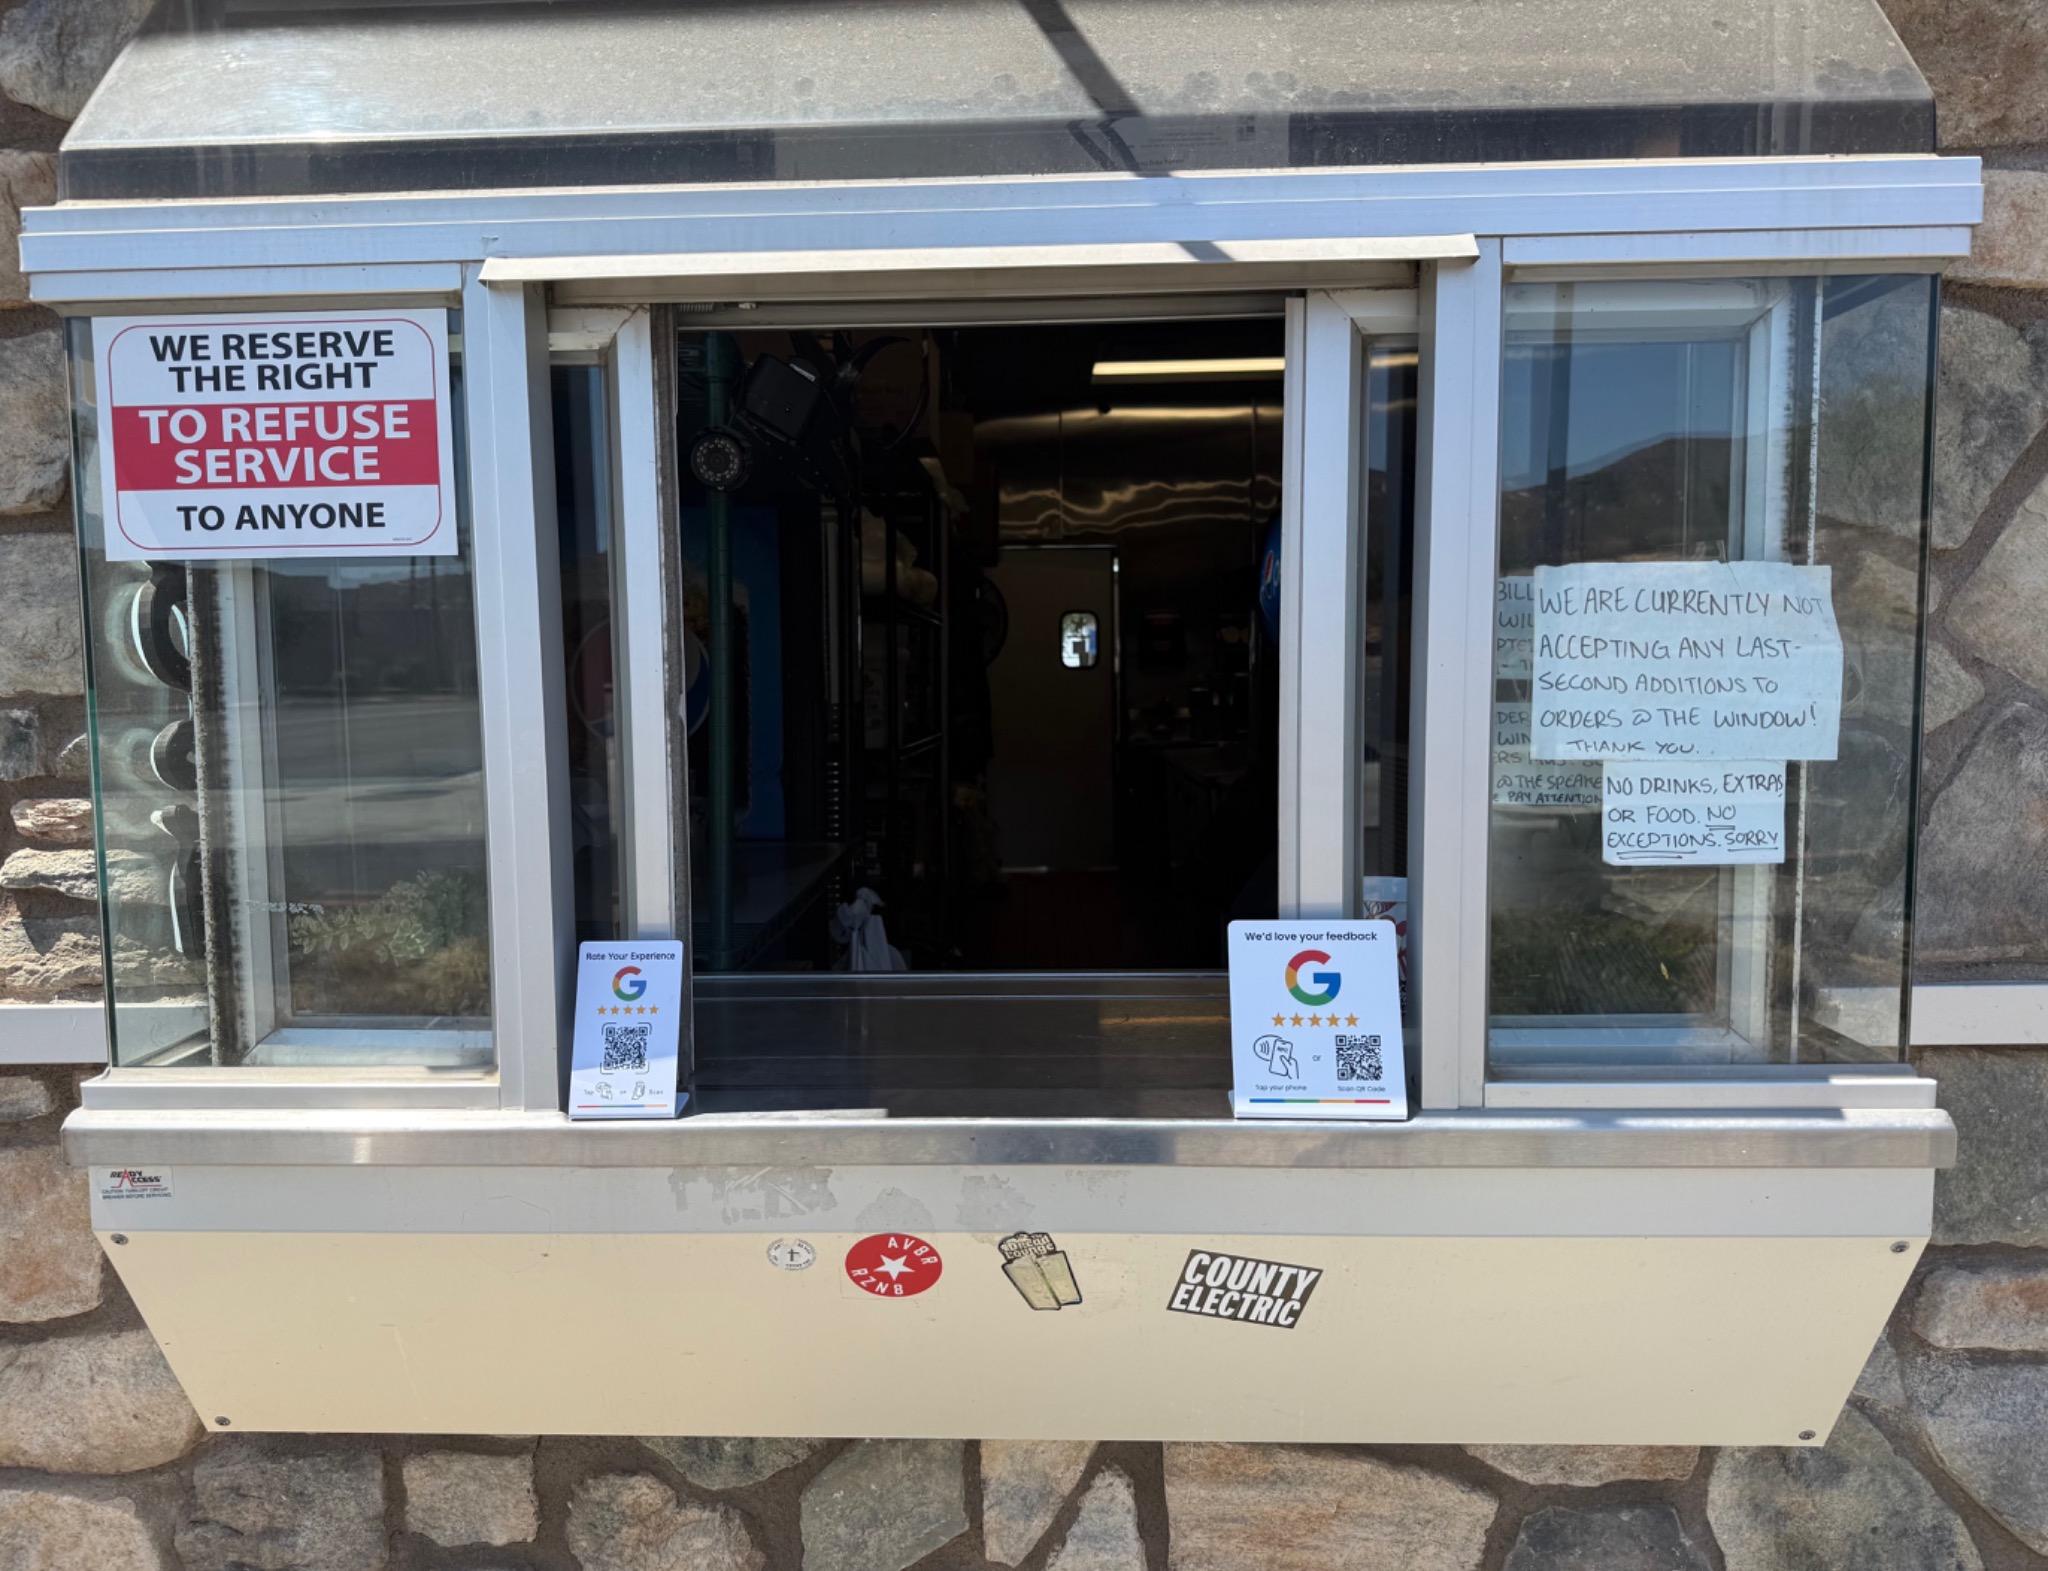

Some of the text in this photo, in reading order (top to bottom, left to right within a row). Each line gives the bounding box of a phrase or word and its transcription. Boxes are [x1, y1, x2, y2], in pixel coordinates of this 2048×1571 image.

[150, 330, 394, 362] WE RESERVE
[168, 362, 378, 393] THE RIGHT
[138, 404, 410, 444] TO REFUSE
[175, 446, 380, 484] SERVICE
[177, 502, 385, 531] TO ANYONE
[1540, 586, 1823, 616] WE ARE CURRENTLY NOT
[1539, 634, 1801, 659] ACCEPTING ANY LAST-
[1538, 671, 1778, 695] SECOND ADDITIONS TO
[1540, 701, 1817, 729] ORDERS @ THE WINDOW!
[1567, 740, 1645, 753] THANK
[1497, 775, 1513, 788] @
[1515, 774, 1543, 789] THE
[1607, 776, 1633, 796] NO
[1640, 777, 1718, 795] DRINKS,
[1507, 791, 1531, 802] PAY
[1608, 804, 1736, 824] OR FOOD. NO
[1607, 829, 1778, 848] EXCEPTIONS. SORRY
[1245, 931, 1378, 943] We'd love your feedback
[586, 951, 676, 962] Rate Your Experience
[612, 966, 647, 1002] G
[1285, 949, 1341, 1006] G
[1185, 1253, 1319, 1300] COUNTY
[1171, 1283, 1300, 1325] ELECTRIC
